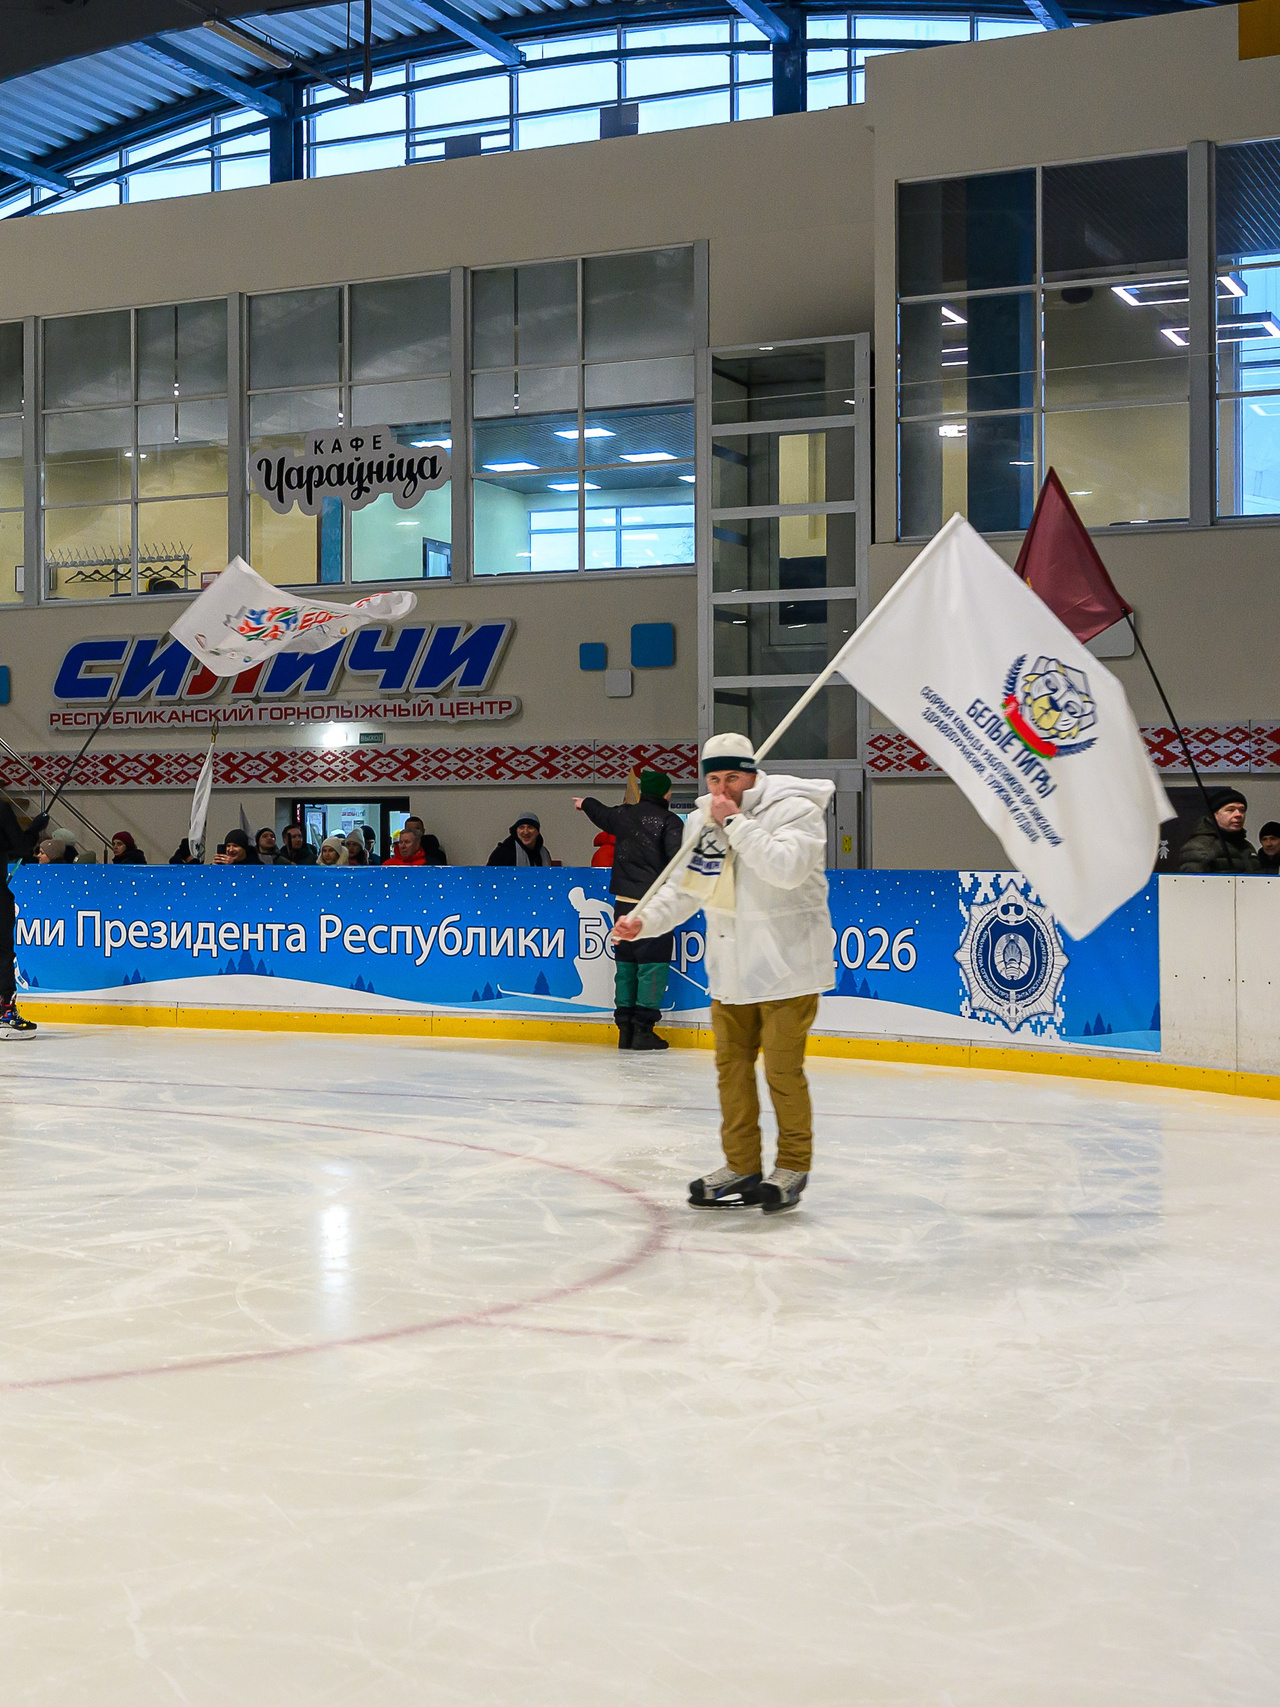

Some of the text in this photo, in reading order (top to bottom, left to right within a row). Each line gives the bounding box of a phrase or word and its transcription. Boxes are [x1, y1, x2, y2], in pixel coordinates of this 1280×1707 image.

[313, 434, 382, 455] КАФЕ
[50, 699, 513, 726] РЕСПУБЛИКАНСКИЙ ГОРНОЛЫЖНЫЙ ЦЕНТР
[360, 734, 383, 742] ВЫХОД
[965, 697, 1058, 799] БЕЛЫЕ ТИГРЫ
[76, 909, 307, 958] Президента
[319, 913, 566, 967] Республики
[830, 925, 918, 972] 026
